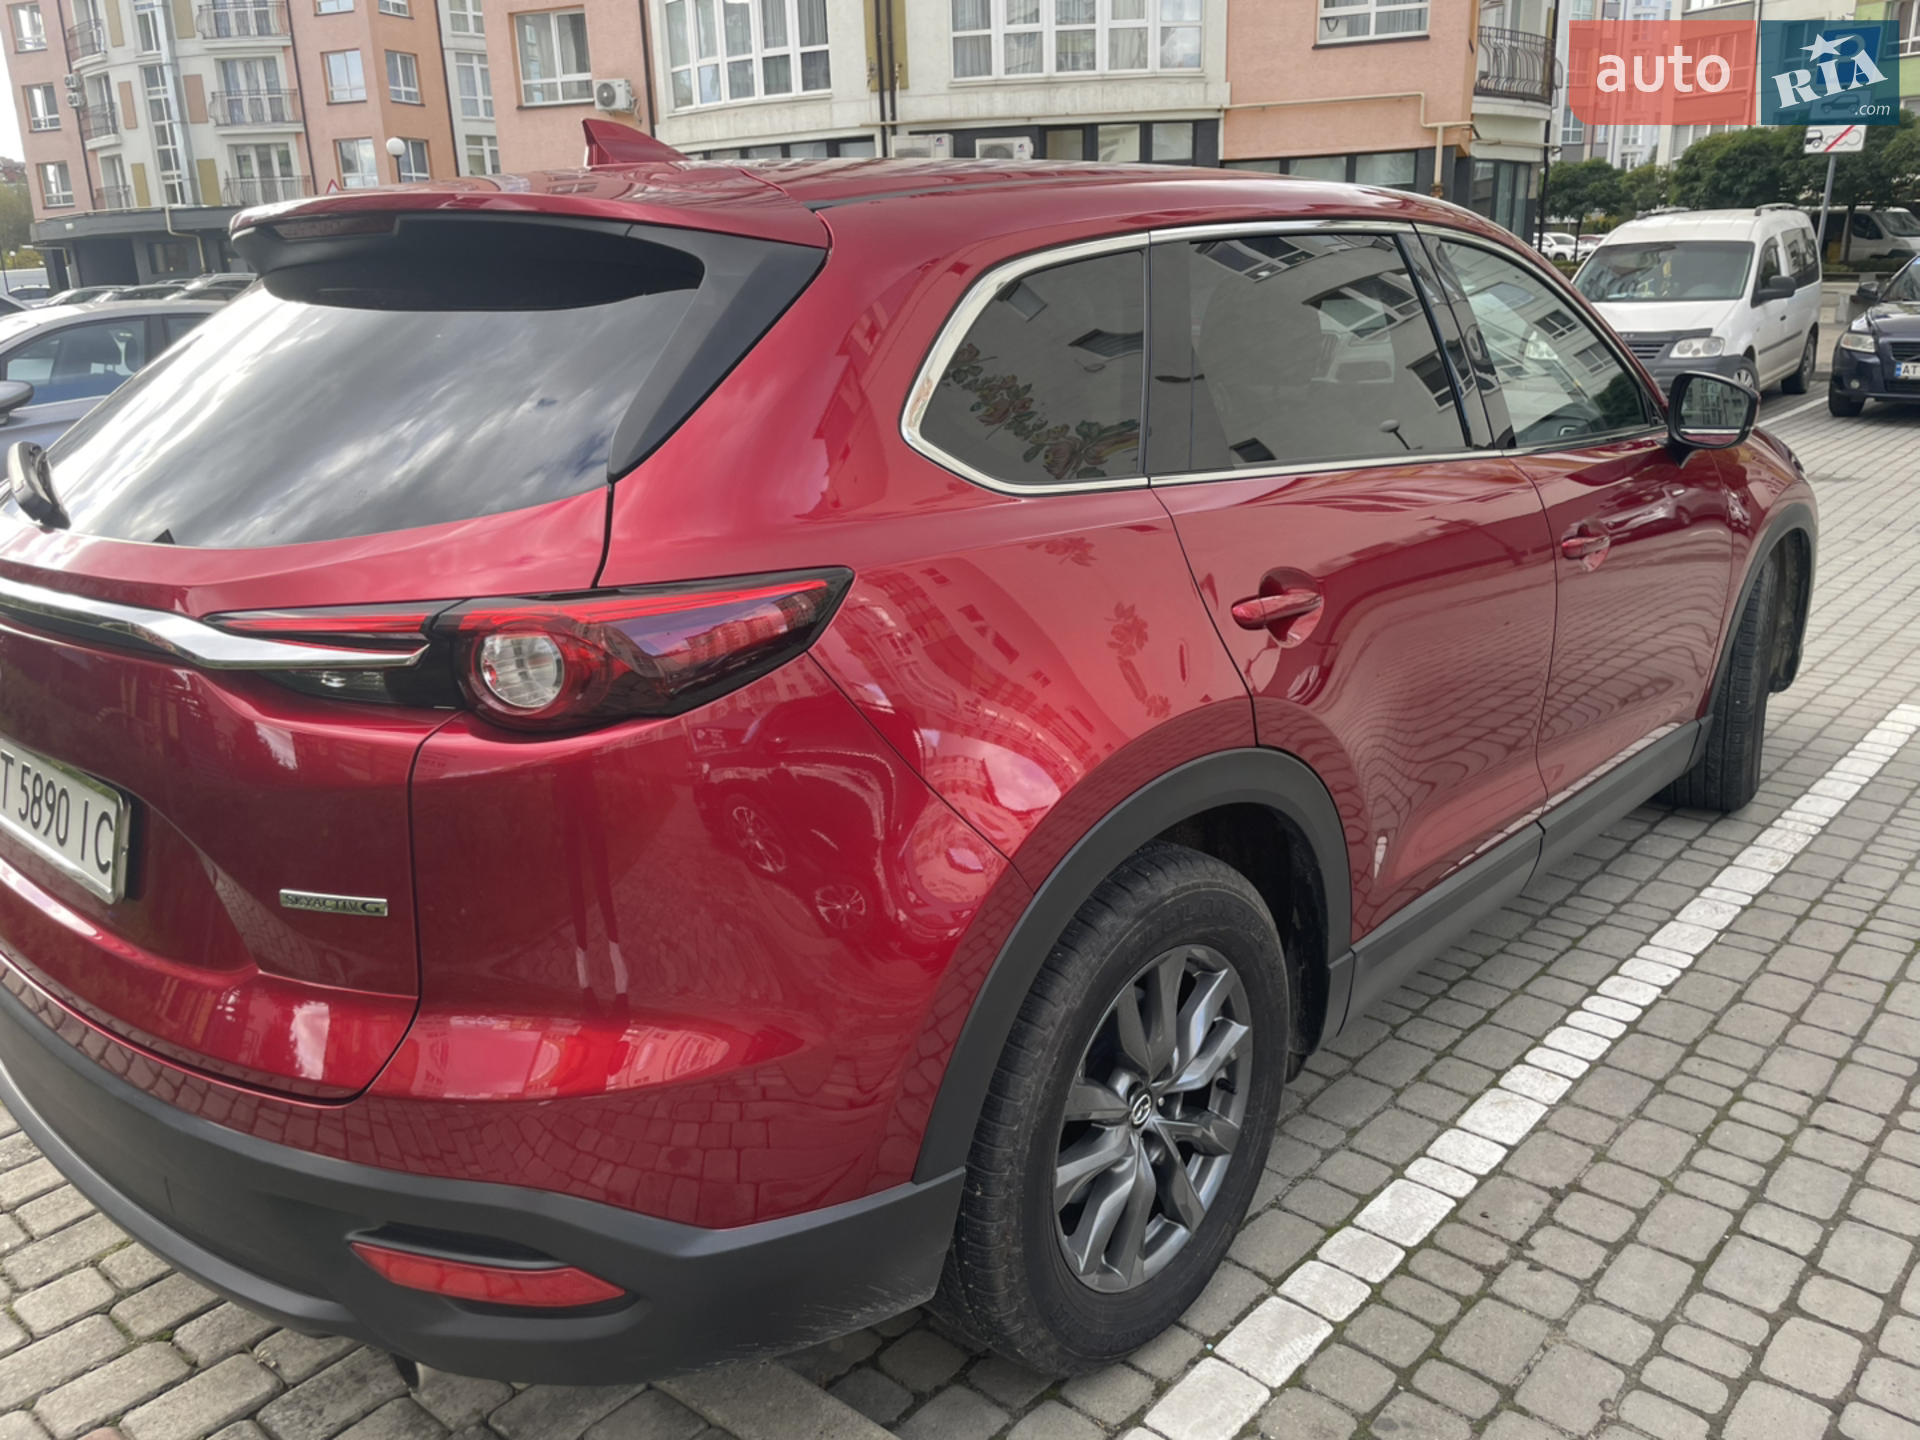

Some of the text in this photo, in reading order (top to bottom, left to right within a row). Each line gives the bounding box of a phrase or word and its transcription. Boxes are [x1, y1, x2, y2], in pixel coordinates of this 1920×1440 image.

[1902, 365, 1918, 375] AT
[18, 762, 70, 847] 5890
[80, 799, 114, 875] IC
